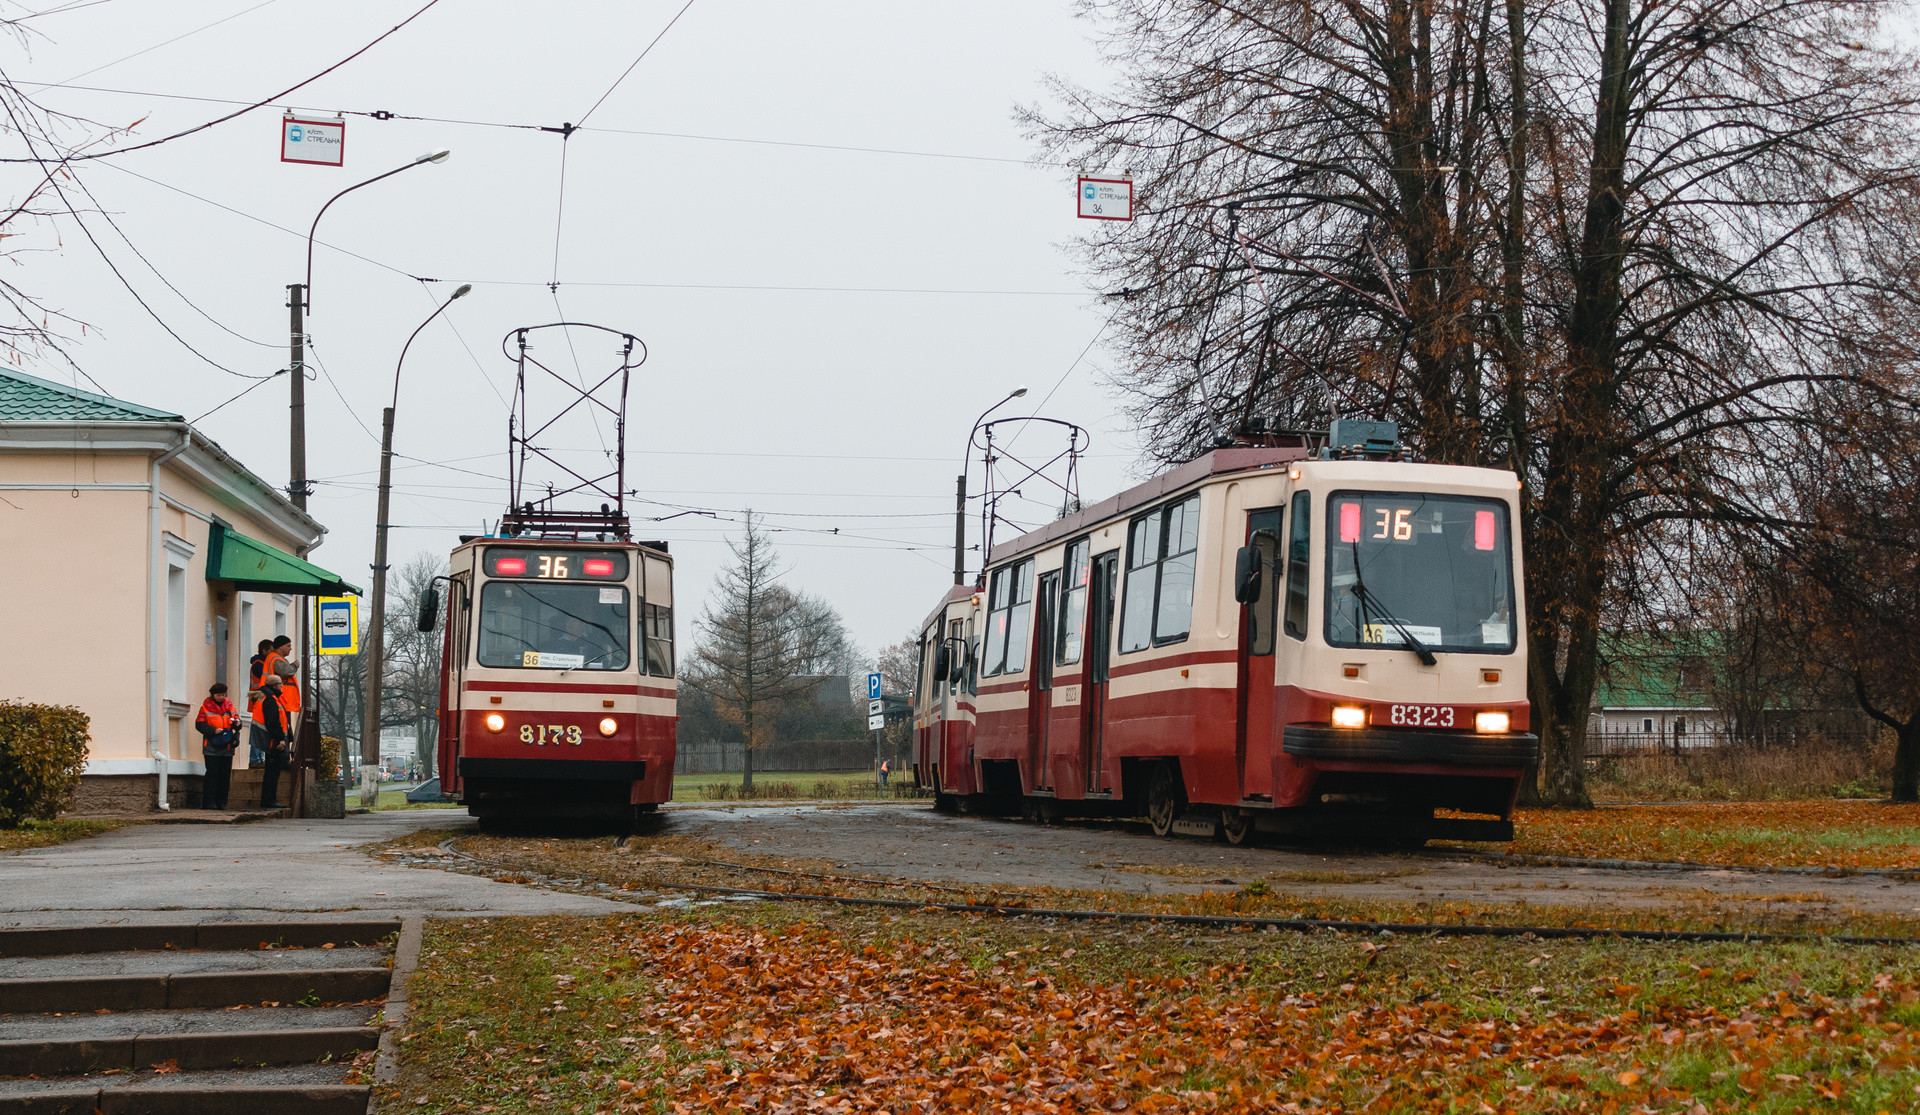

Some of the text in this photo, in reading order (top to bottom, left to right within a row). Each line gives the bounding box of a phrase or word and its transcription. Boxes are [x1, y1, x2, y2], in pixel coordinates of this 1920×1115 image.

[307, 136, 341, 144] СТРЕЛЬНА
[1093, 204, 1103, 214] 36
[1372, 508, 1413, 541] 36
[537, 555, 569, 579] 36
[1366, 629, 1383, 643] 36
[524, 655, 539, 665] 36
[871, 676, 879, 696] P
[1390, 704, 1455, 727] 8323
[519, 724, 582, 746] 8173
